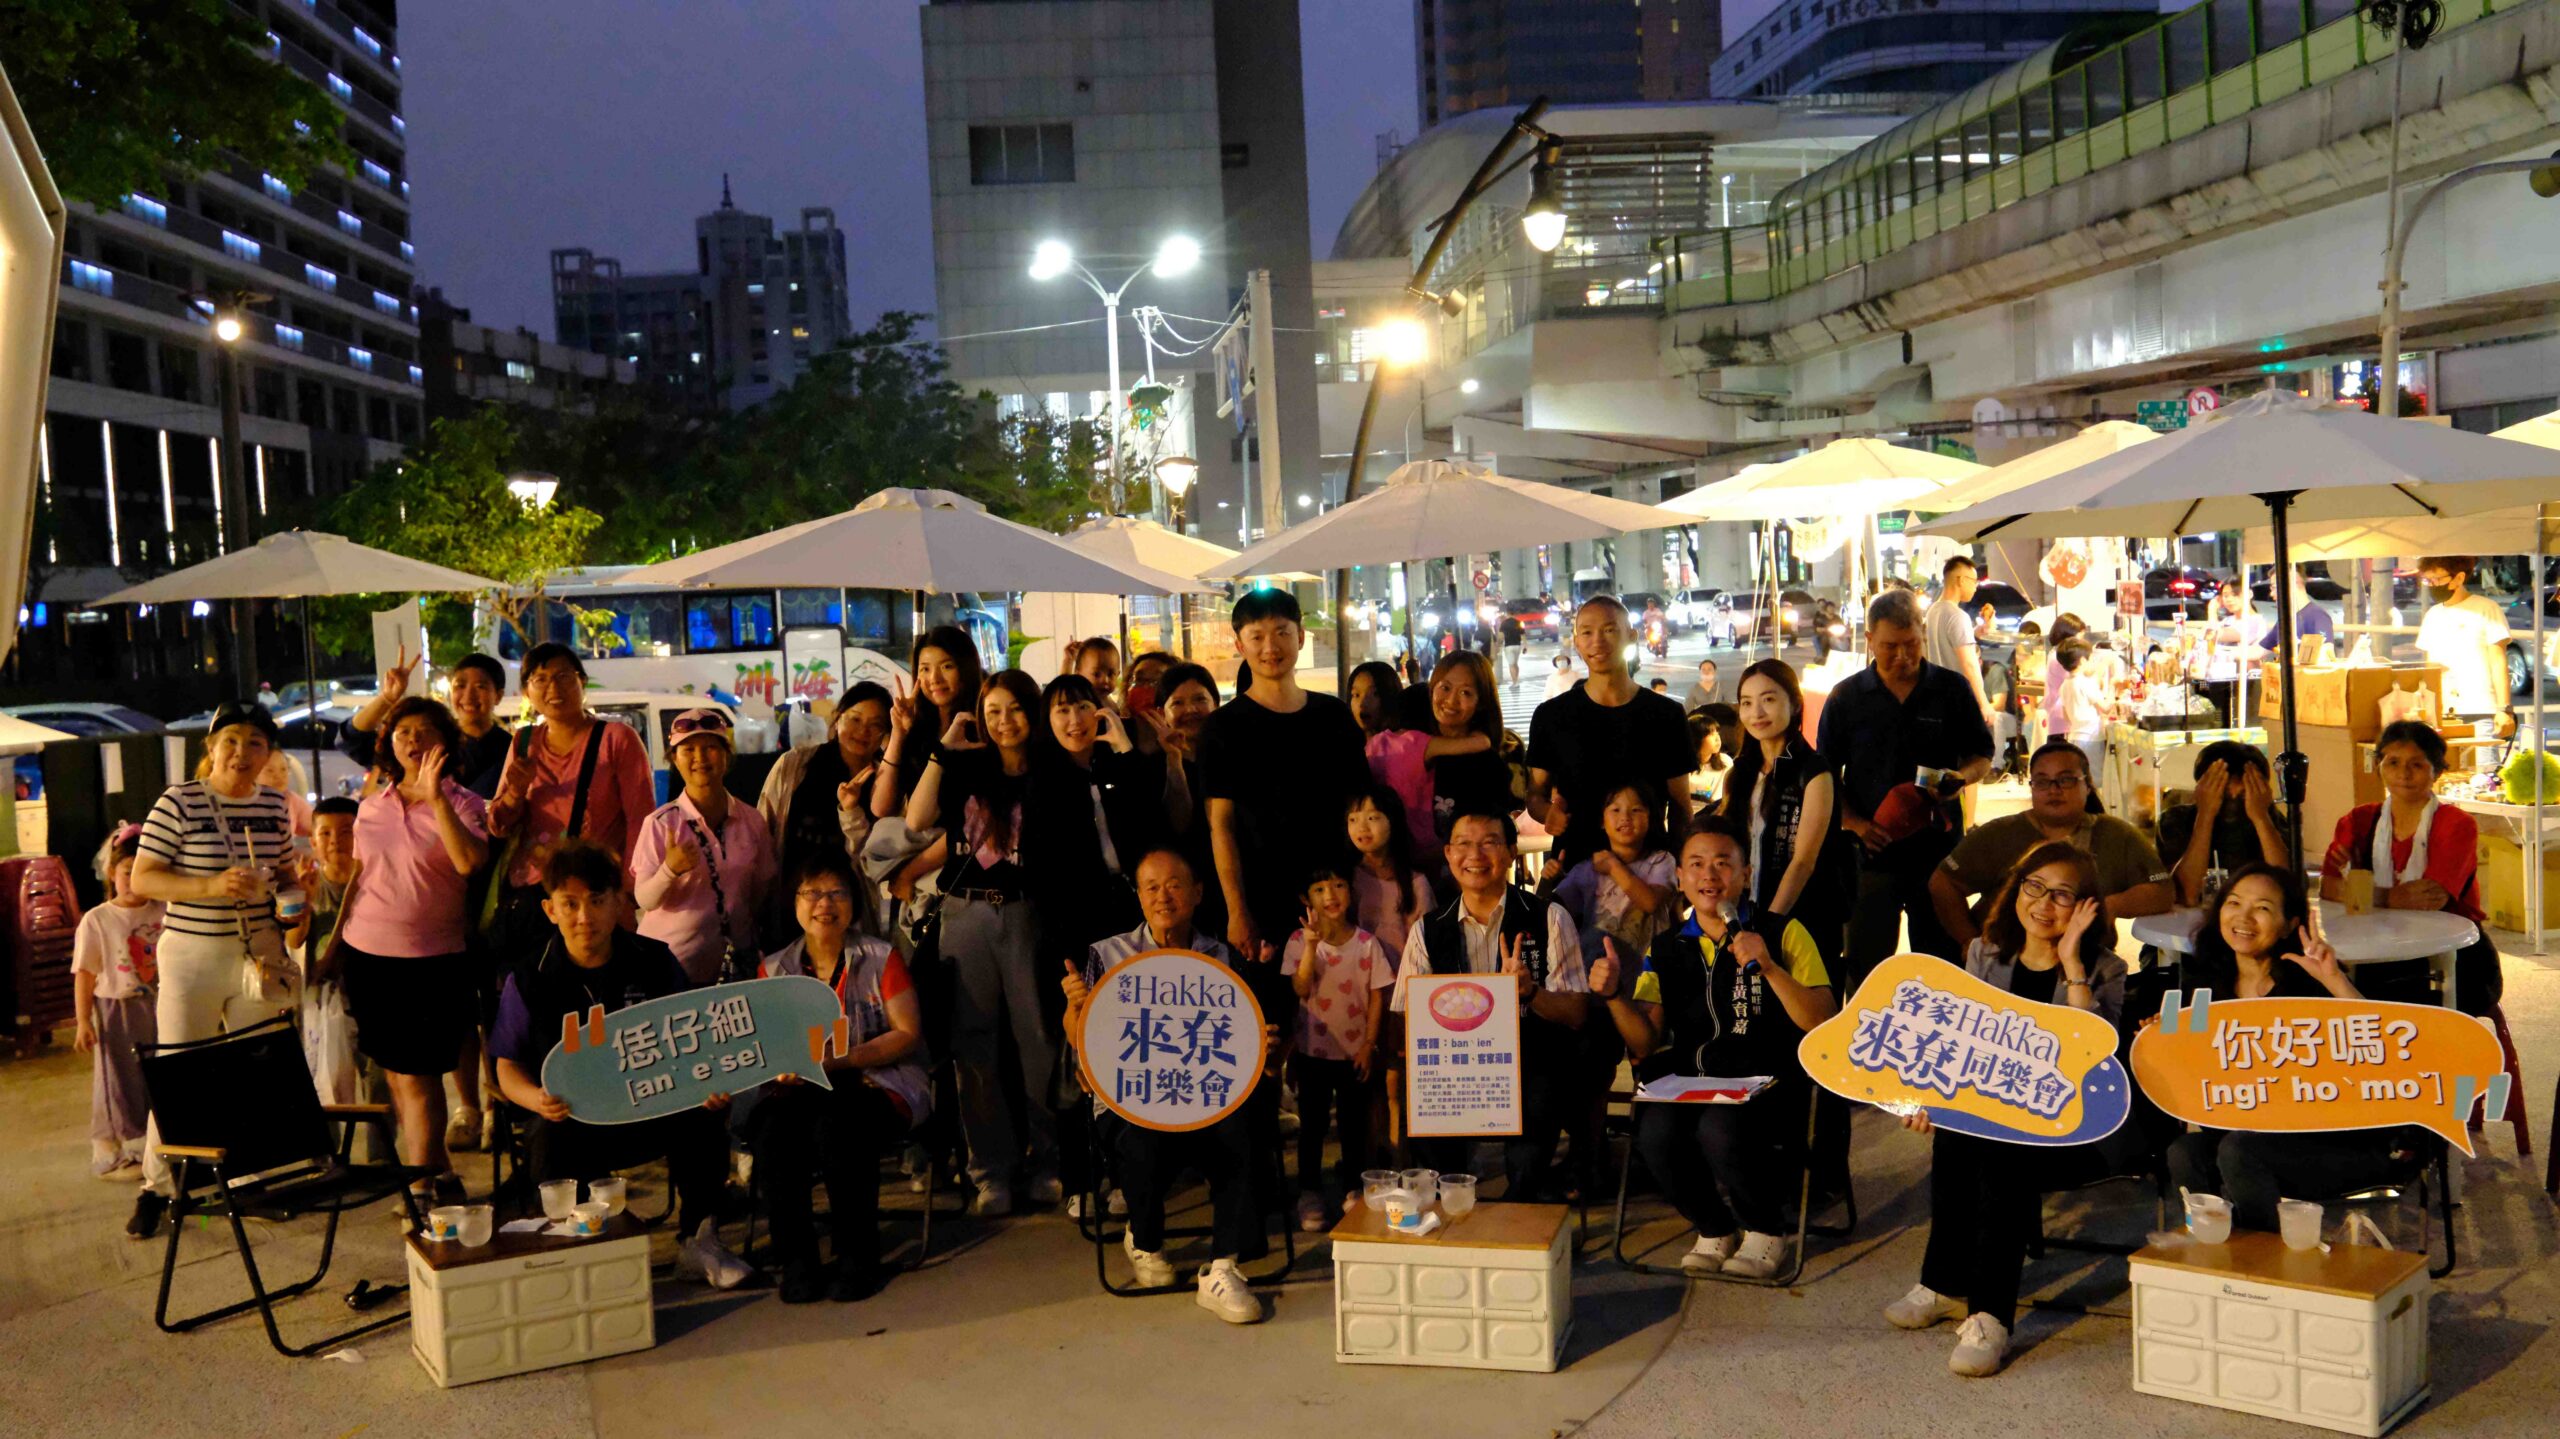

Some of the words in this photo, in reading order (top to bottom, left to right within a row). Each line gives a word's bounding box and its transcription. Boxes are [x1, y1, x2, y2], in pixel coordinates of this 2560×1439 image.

[1134, 974, 1237, 1008] Hakka
[611, 994, 756, 1073] 恁仔細
[2212, 1014, 2418, 1070] 你好嗎?
[1116, 1067, 1235, 1108] 同樂會
